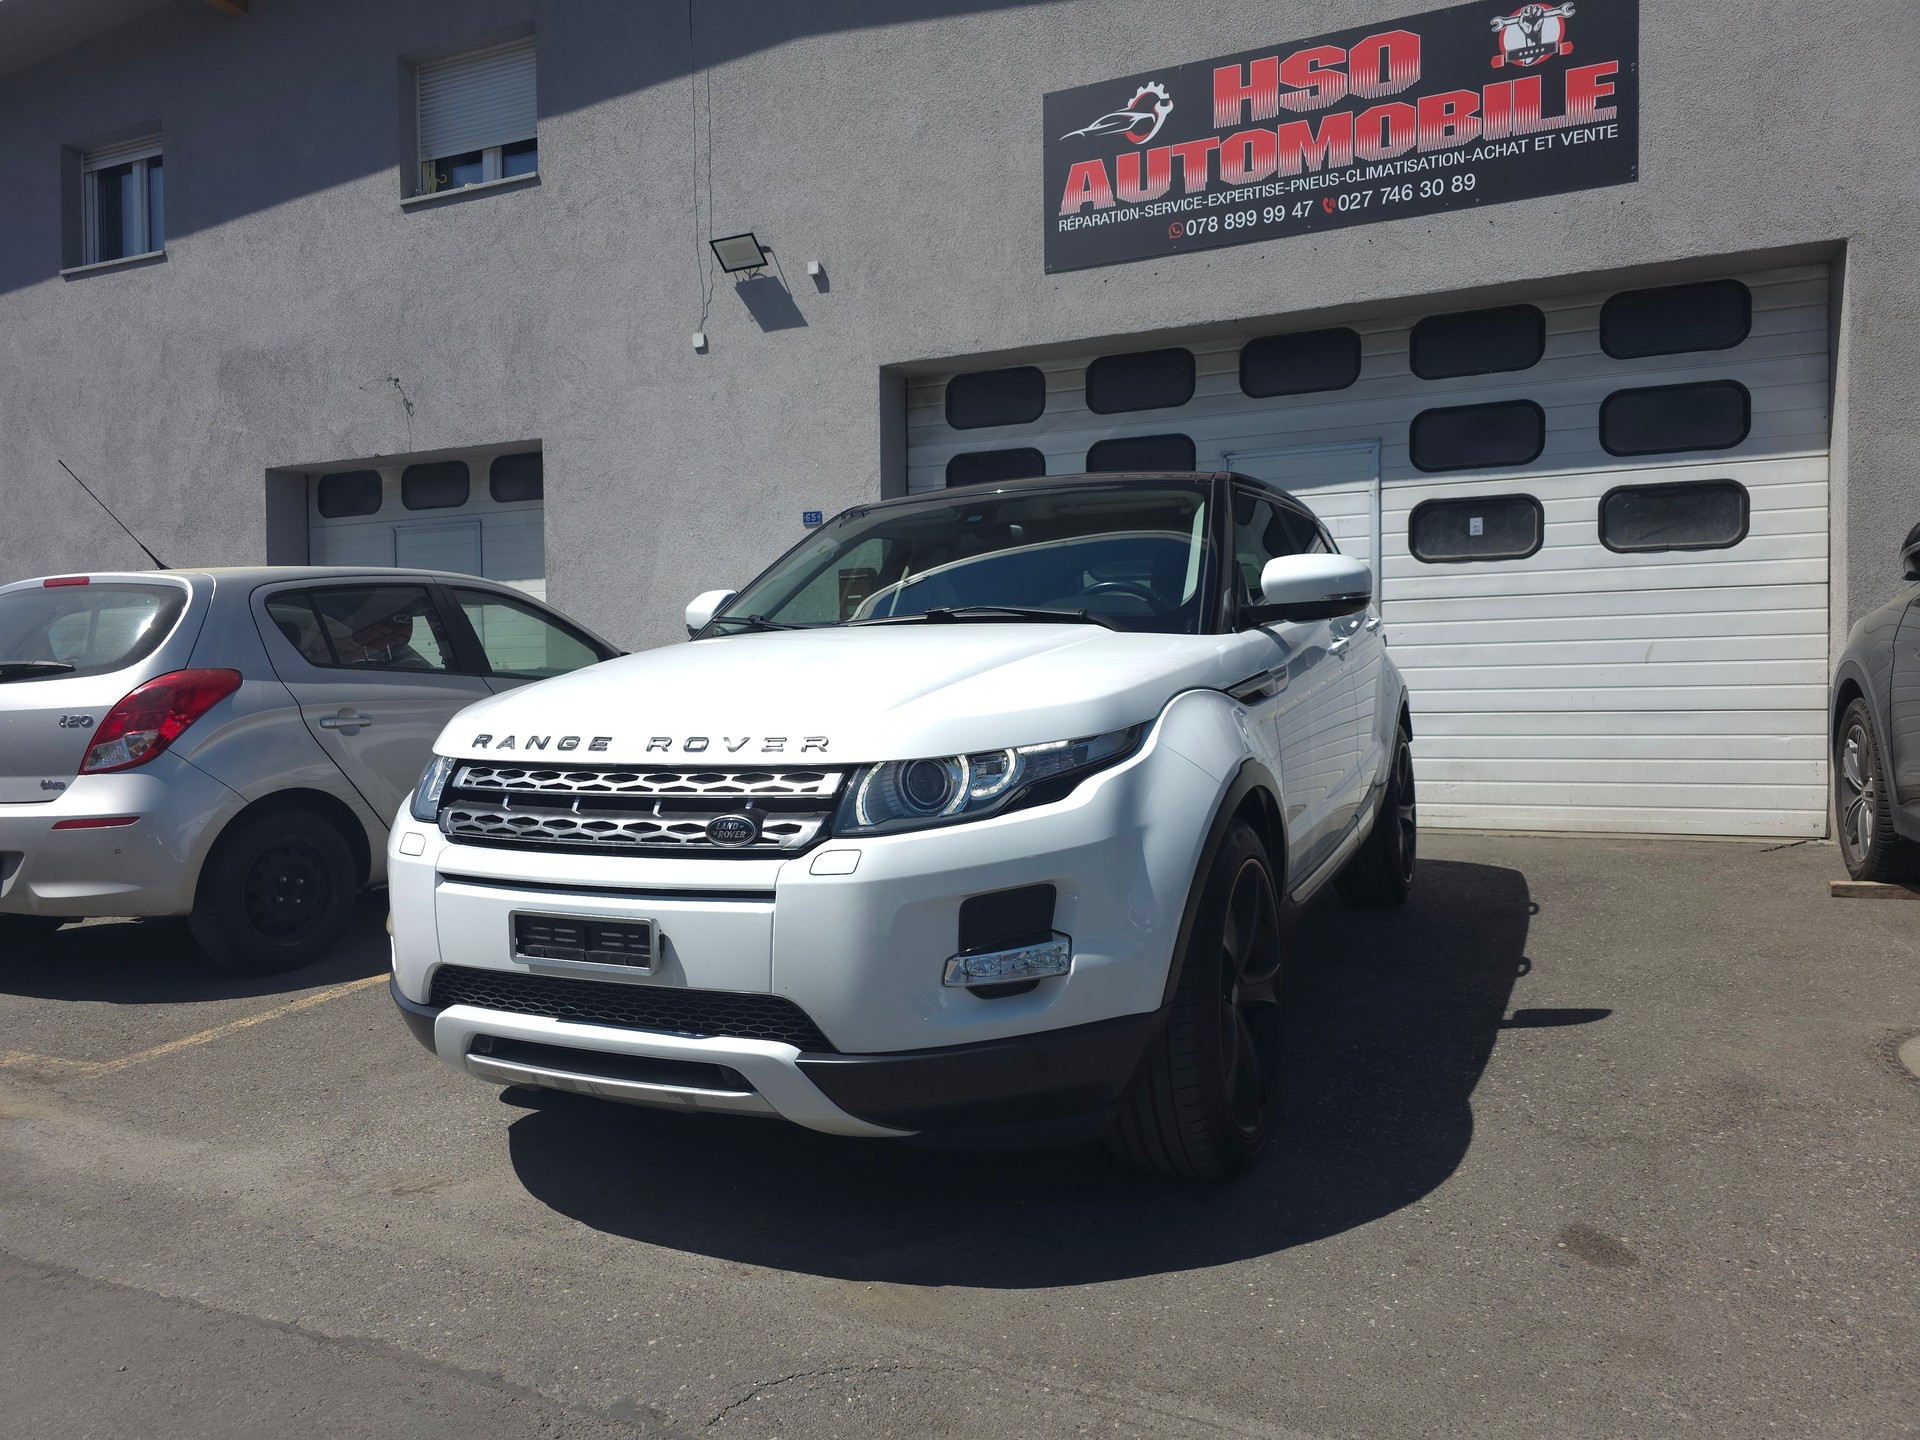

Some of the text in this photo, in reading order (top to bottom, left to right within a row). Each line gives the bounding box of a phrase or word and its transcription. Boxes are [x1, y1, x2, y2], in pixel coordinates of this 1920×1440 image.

[1213, 29, 1421, 129] HSO
[1058, 60, 1619, 216] AUTOMOBILE
[1534, 134, 1556, 151] ET
[1563, 123, 1619, 147] VENTE
[1186, 172, 1476, 237] 078 899 99 47 027 746 30 89
[806, 513, 817, 522] 65
[471, 733, 829, 753] RANGE ROVER
[717, 830, 746, 839] ROVER
